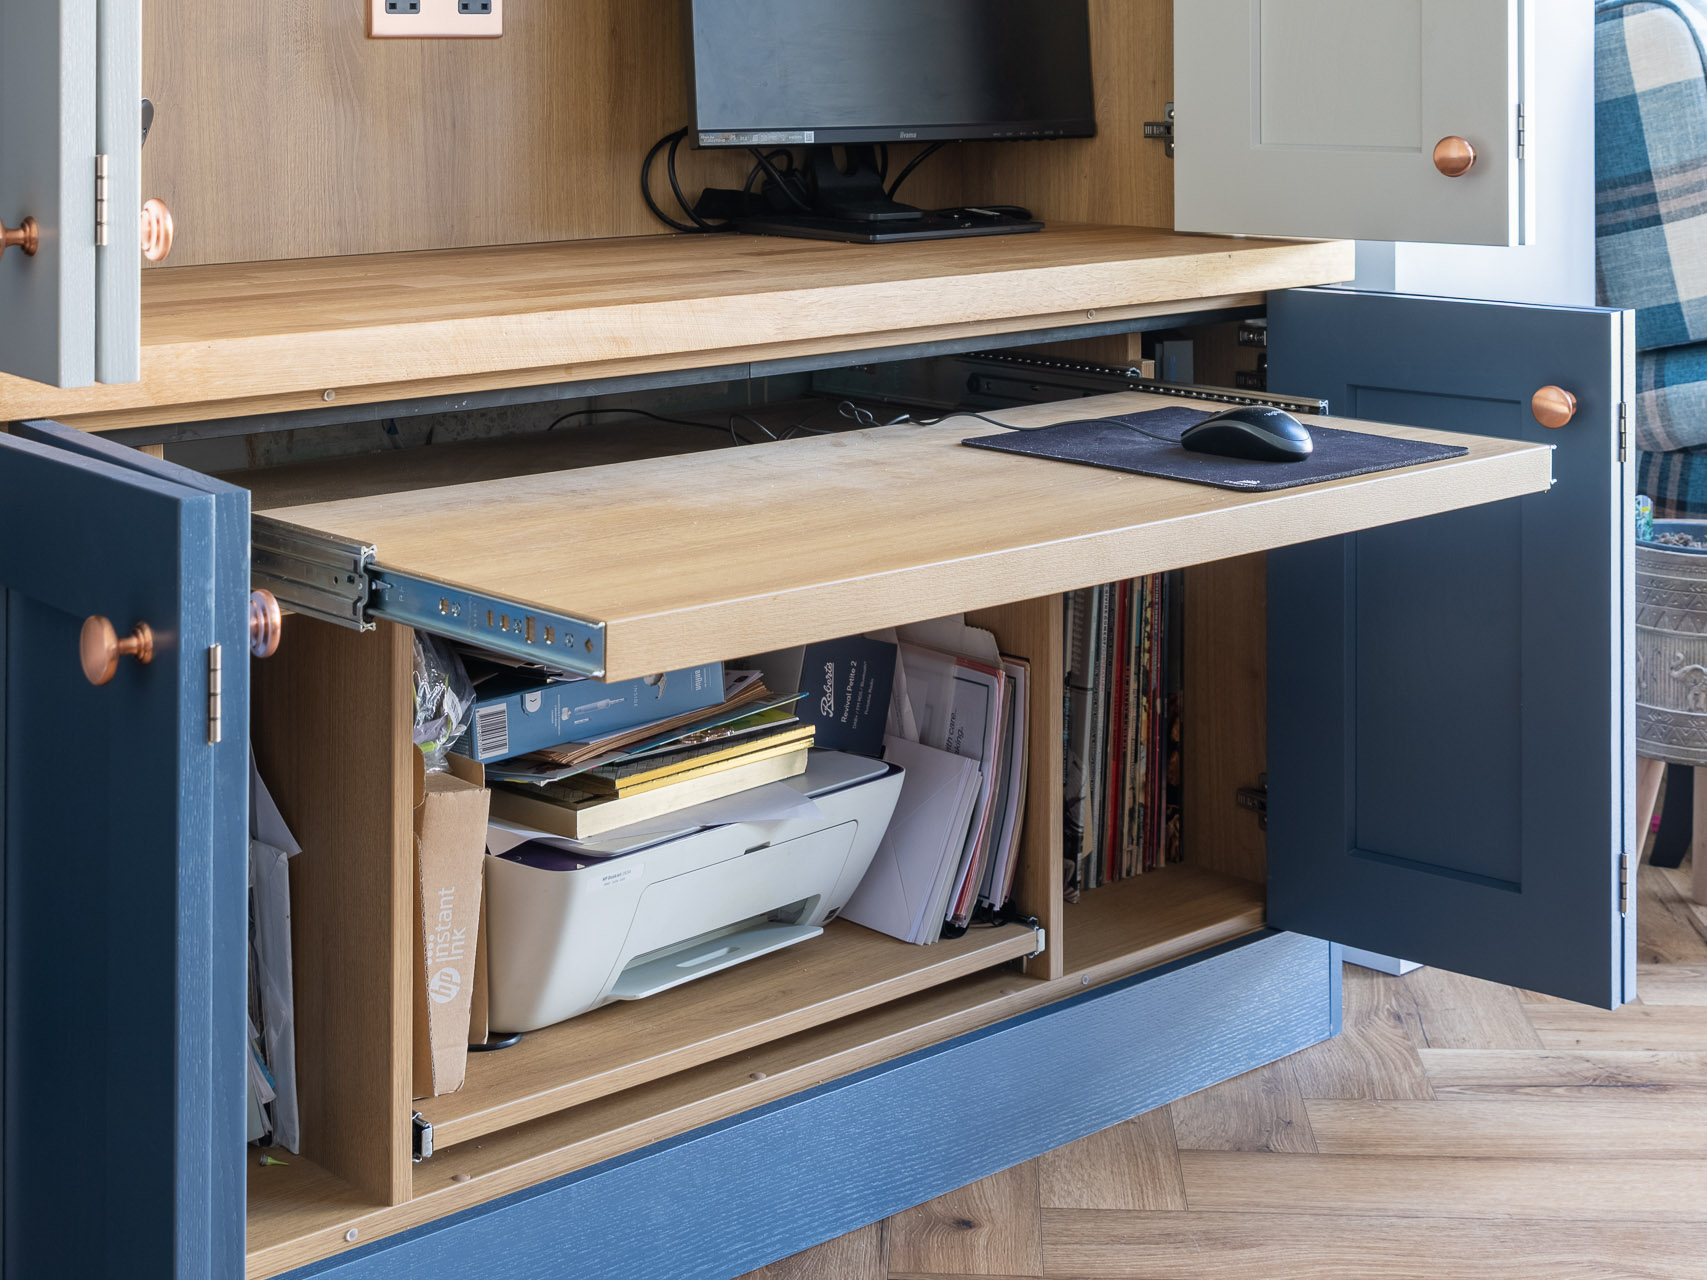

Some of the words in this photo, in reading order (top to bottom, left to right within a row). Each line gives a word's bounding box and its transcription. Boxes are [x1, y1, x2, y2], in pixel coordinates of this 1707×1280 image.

[820, 661, 835, 718] Roberts
[840, 693, 852, 723] Revival
[846, 668, 856, 692] Petite
[435, 886, 455, 962] Instant
[450, 927, 466, 961] Ink
[430, 968, 461, 1003] hp
